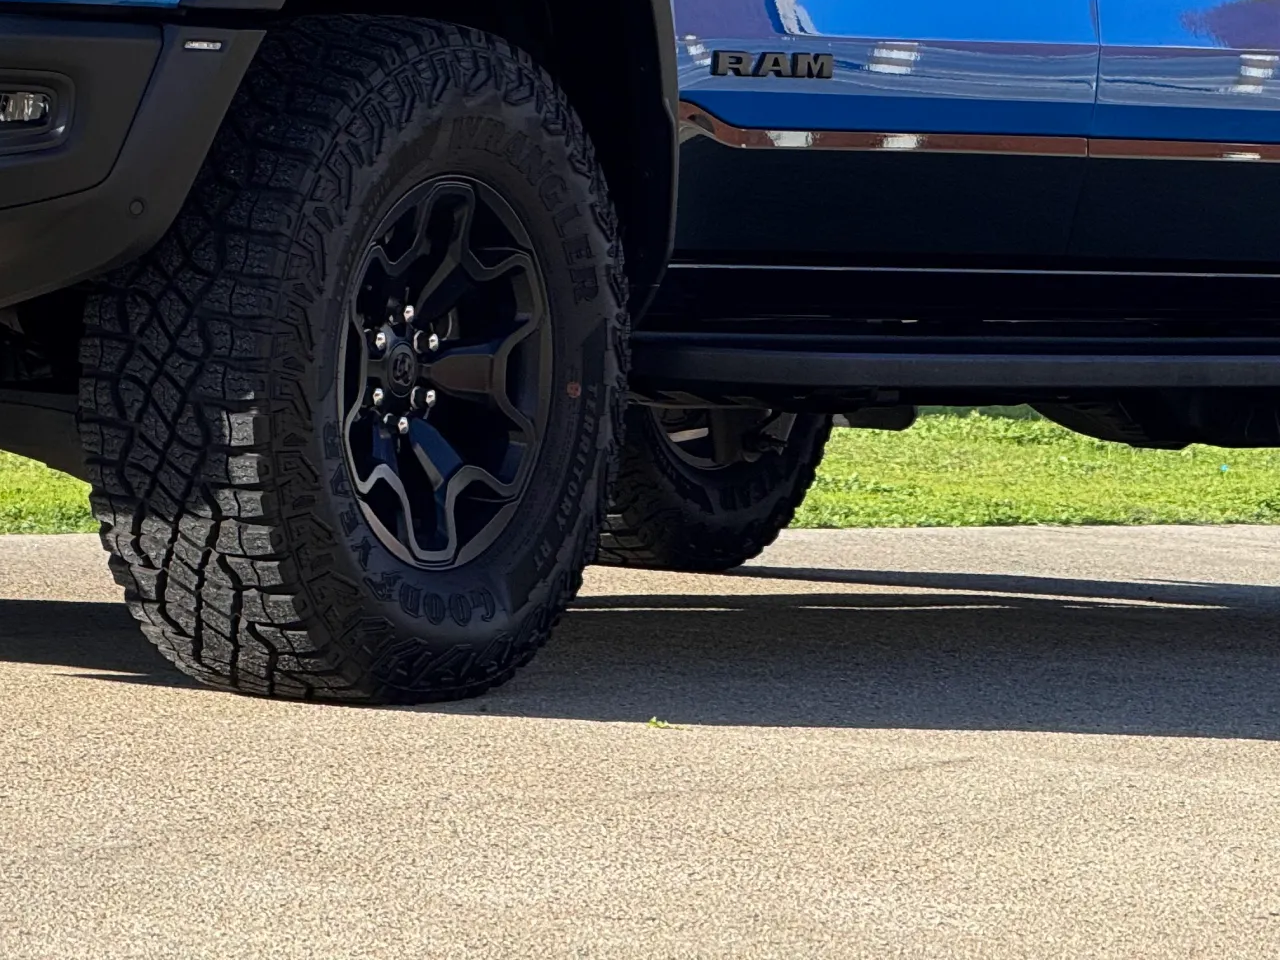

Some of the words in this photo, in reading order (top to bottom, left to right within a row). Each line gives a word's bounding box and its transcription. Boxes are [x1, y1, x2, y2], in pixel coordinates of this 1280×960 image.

[710, 49, 833, 79] RAM
[448, 114, 600, 305] WRANGLER
[555, 381, 599, 532] TERRITORY
